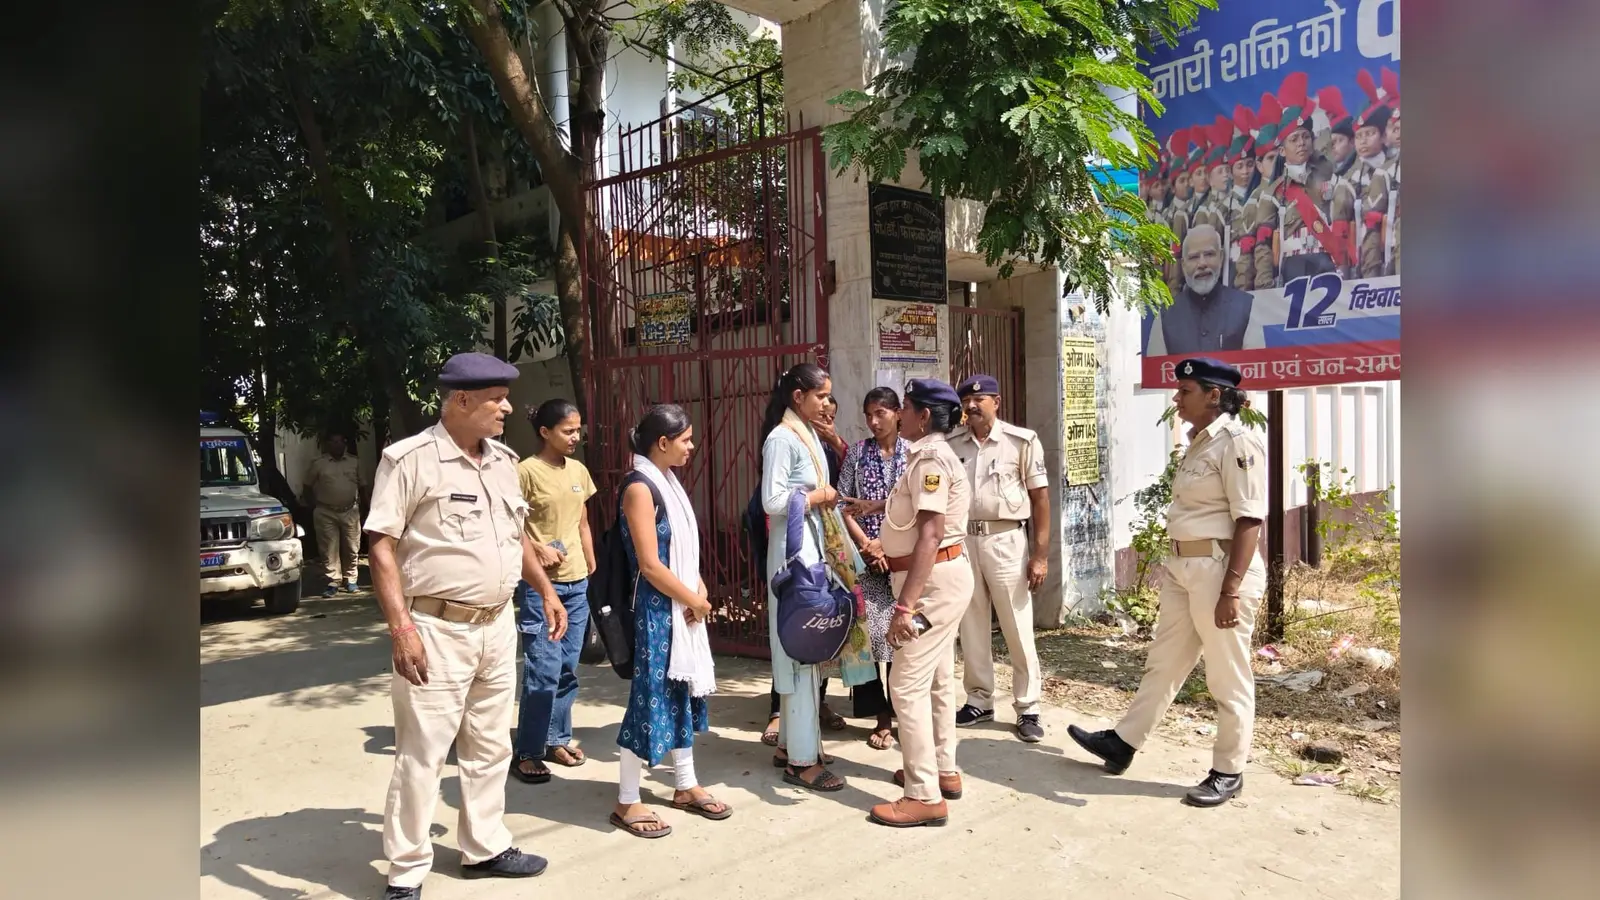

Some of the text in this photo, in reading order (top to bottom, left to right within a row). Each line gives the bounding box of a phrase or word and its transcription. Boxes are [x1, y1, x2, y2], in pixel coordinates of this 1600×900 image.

[1150, 39, 1214, 99] नारी
[1220, 18, 1293, 83] शक्ति
[1296, 0, 1346, 59] को
[1284, 273, 1342, 331] 12
[1317, 315, 1334, 325] साल
[1066, 347, 1095, 368] ओम IAS
[1271, 354, 1302, 379] एवं
[1067, 421, 1096, 441] ओम IAS
[206, 439, 237, 449] पुलिस
